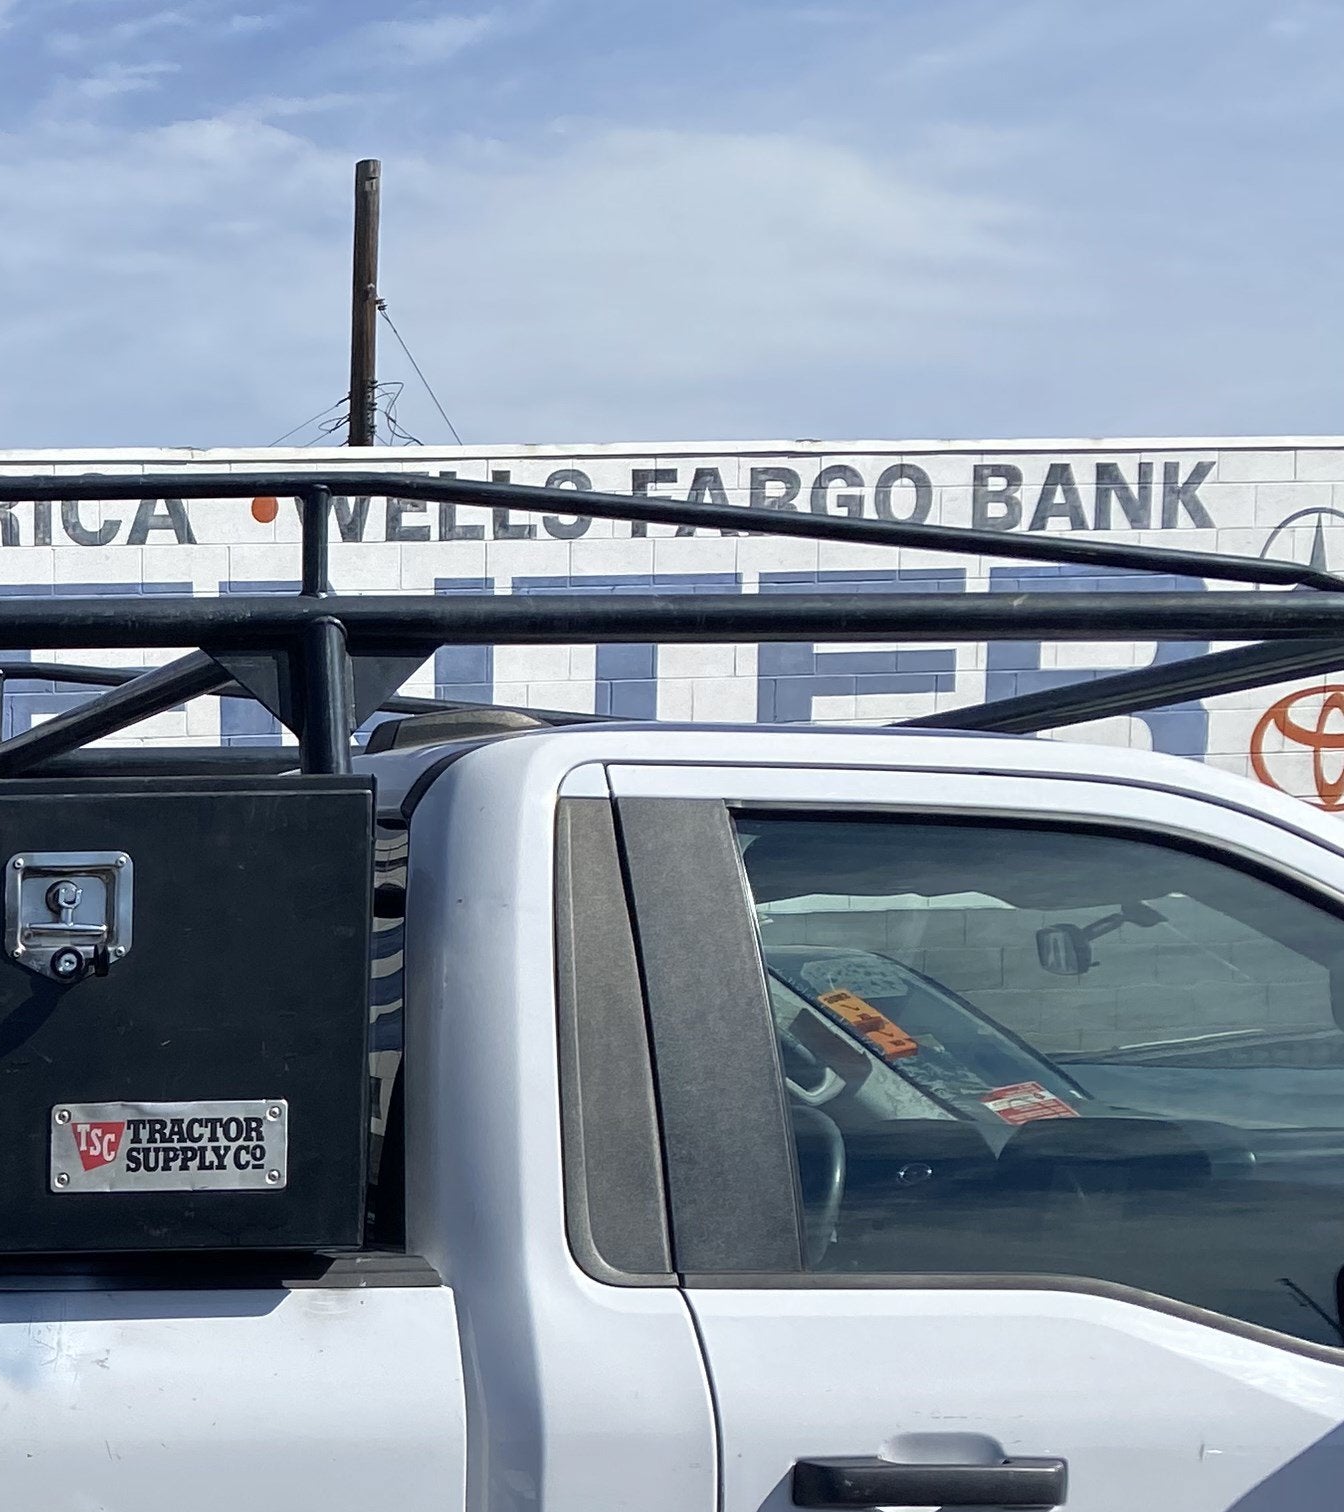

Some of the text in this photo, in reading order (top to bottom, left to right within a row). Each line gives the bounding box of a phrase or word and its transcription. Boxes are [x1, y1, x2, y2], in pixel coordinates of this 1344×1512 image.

[631, 463, 934, 538] FARGO
[971, 460, 1218, 533] BANK
[76, 1123, 116, 1163] TSC
[126, 1116, 265, 1144] TRACTOR
[125, 1146, 231, 1173] SUPPLY
